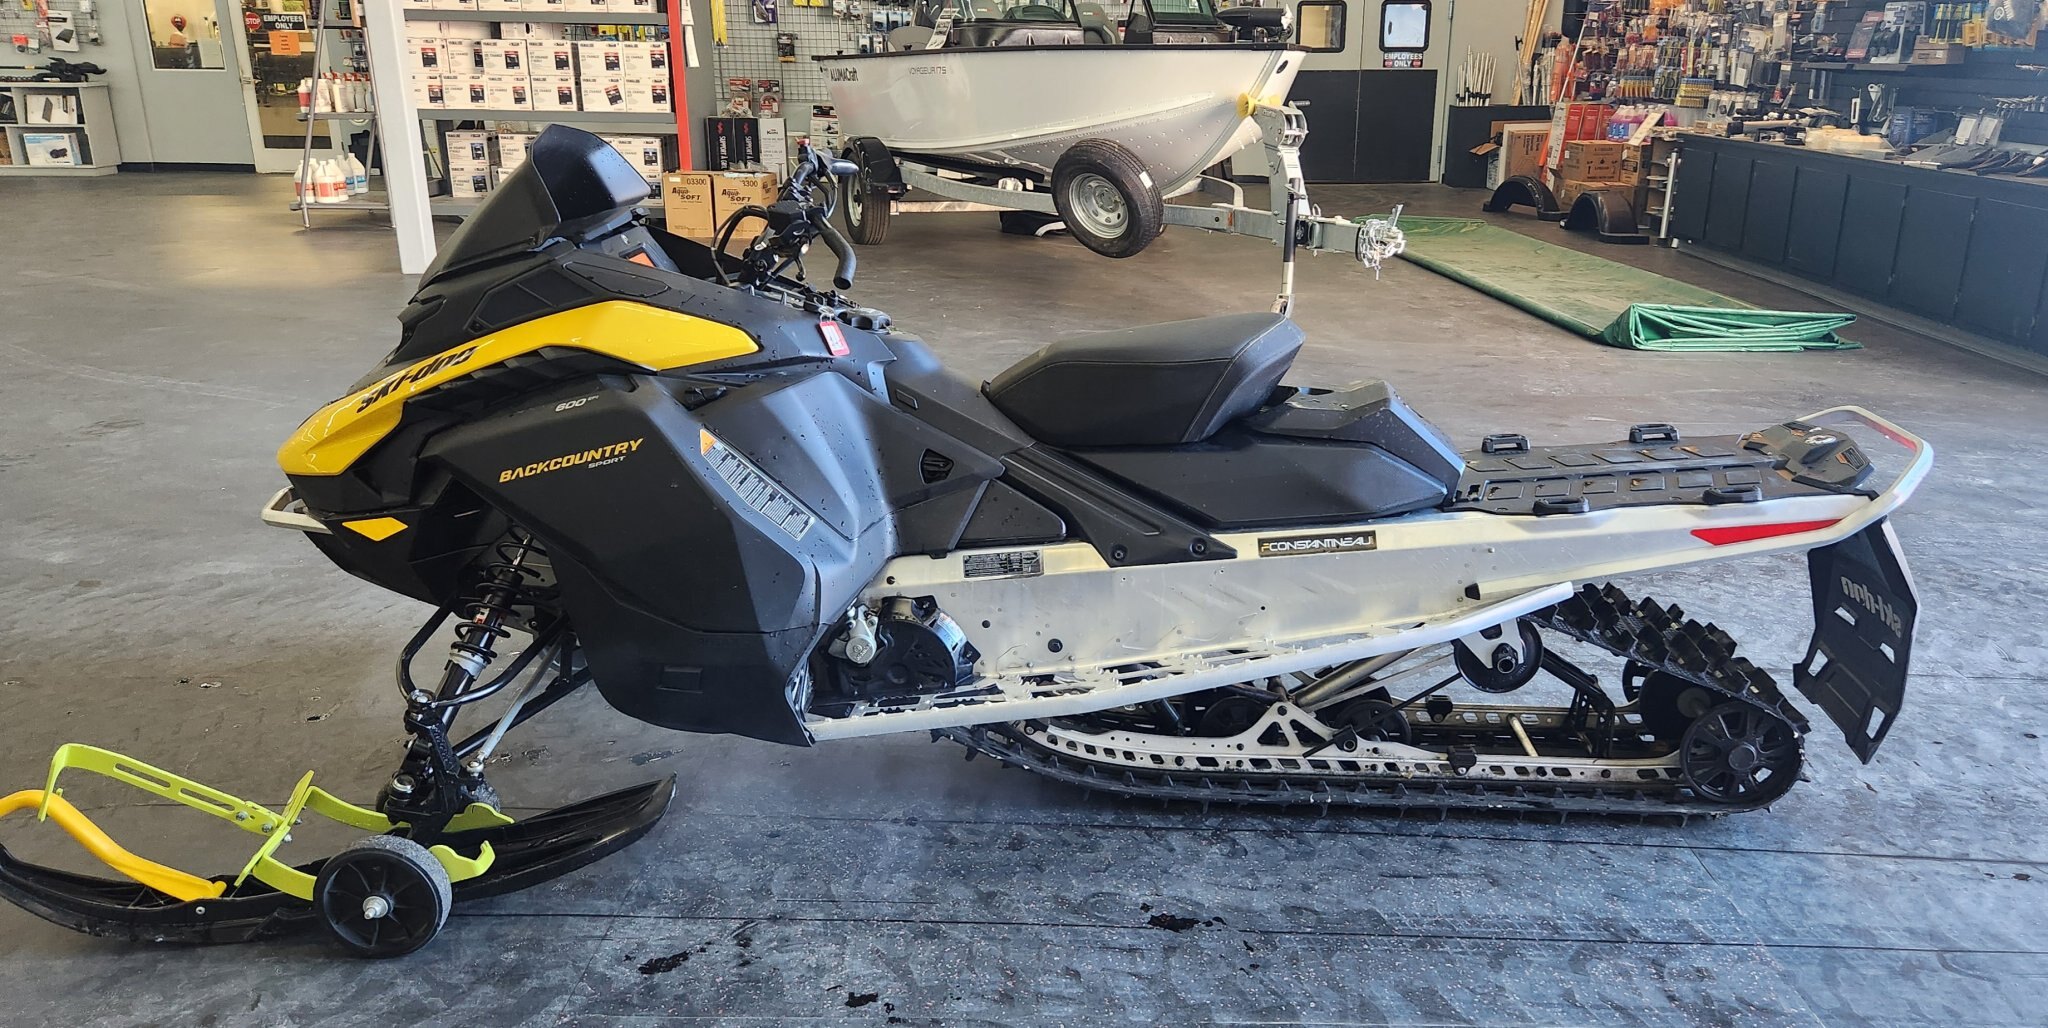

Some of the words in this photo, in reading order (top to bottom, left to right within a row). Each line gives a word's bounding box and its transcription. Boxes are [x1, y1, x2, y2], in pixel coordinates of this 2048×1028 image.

[263, 14, 304, 23] EMPLOYEES
[275, 22, 294, 30] ONLY
[1384, 52, 1423, 60] EMPLOYEES
[686, 178, 707, 186] 03300
[740, 180, 758, 188] 3300
[555, 398, 587, 413] 600
[498, 437, 645, 484] BACKCOUNTRY
[587, 455, 627, 470] SPORT
